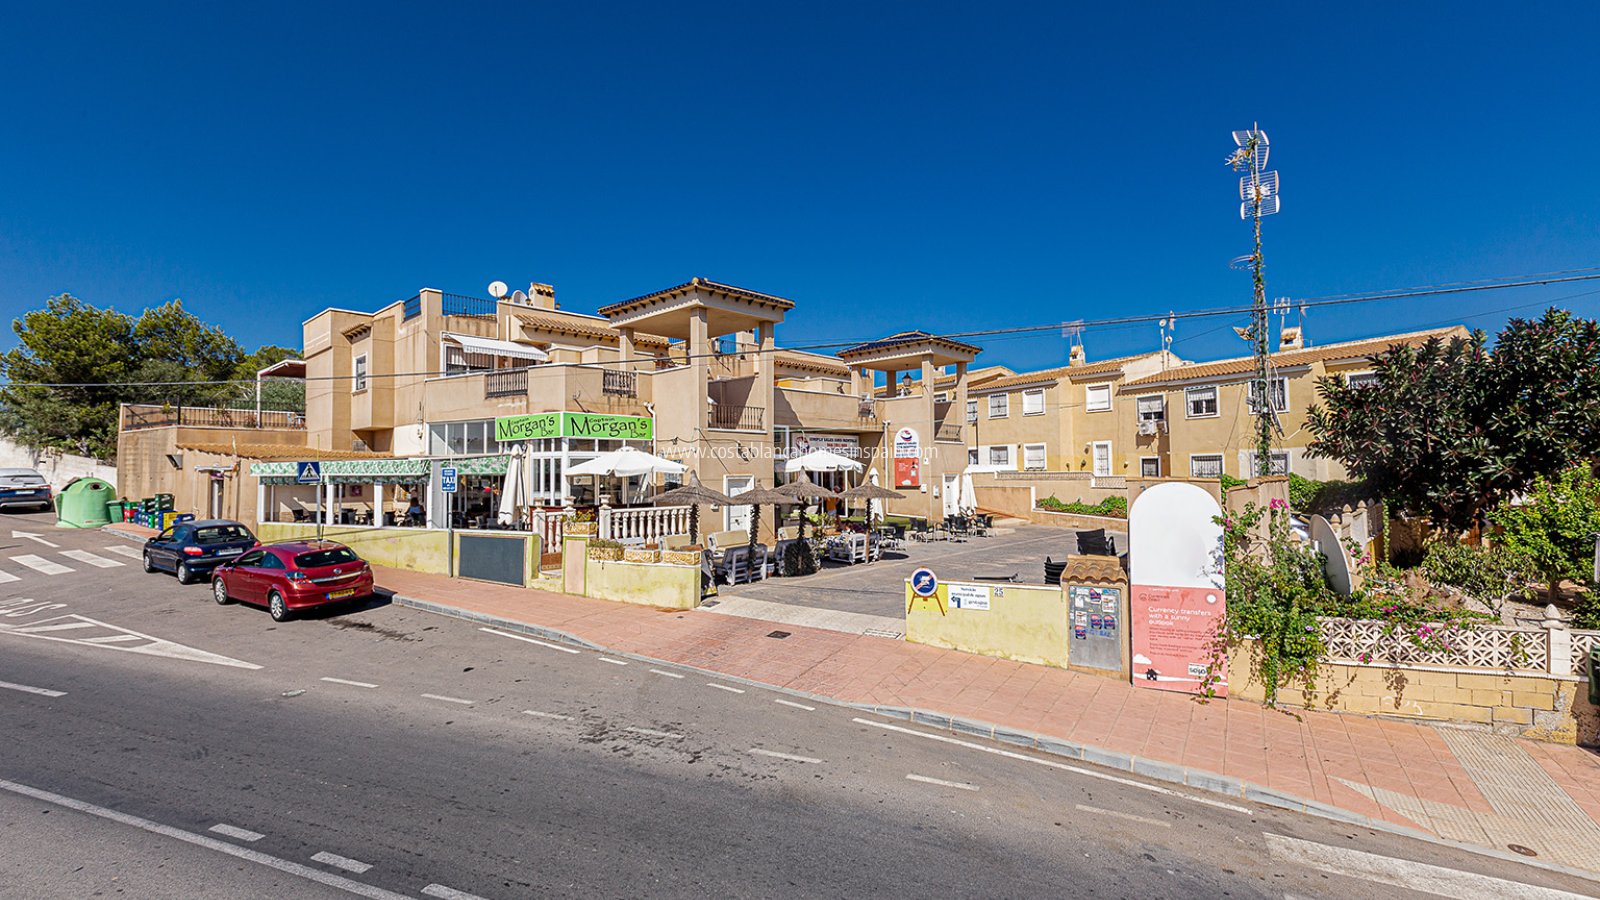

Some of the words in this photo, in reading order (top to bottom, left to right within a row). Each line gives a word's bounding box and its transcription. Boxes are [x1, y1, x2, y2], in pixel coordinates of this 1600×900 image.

[499, 415, 555, 439] Morgan's
[540, 427, 554, 437] Bar
[571, 416, 648, 437] Morgan's
[630, 428, 646, 439] Bar
[1148, 607, 1178, 615] Currency
